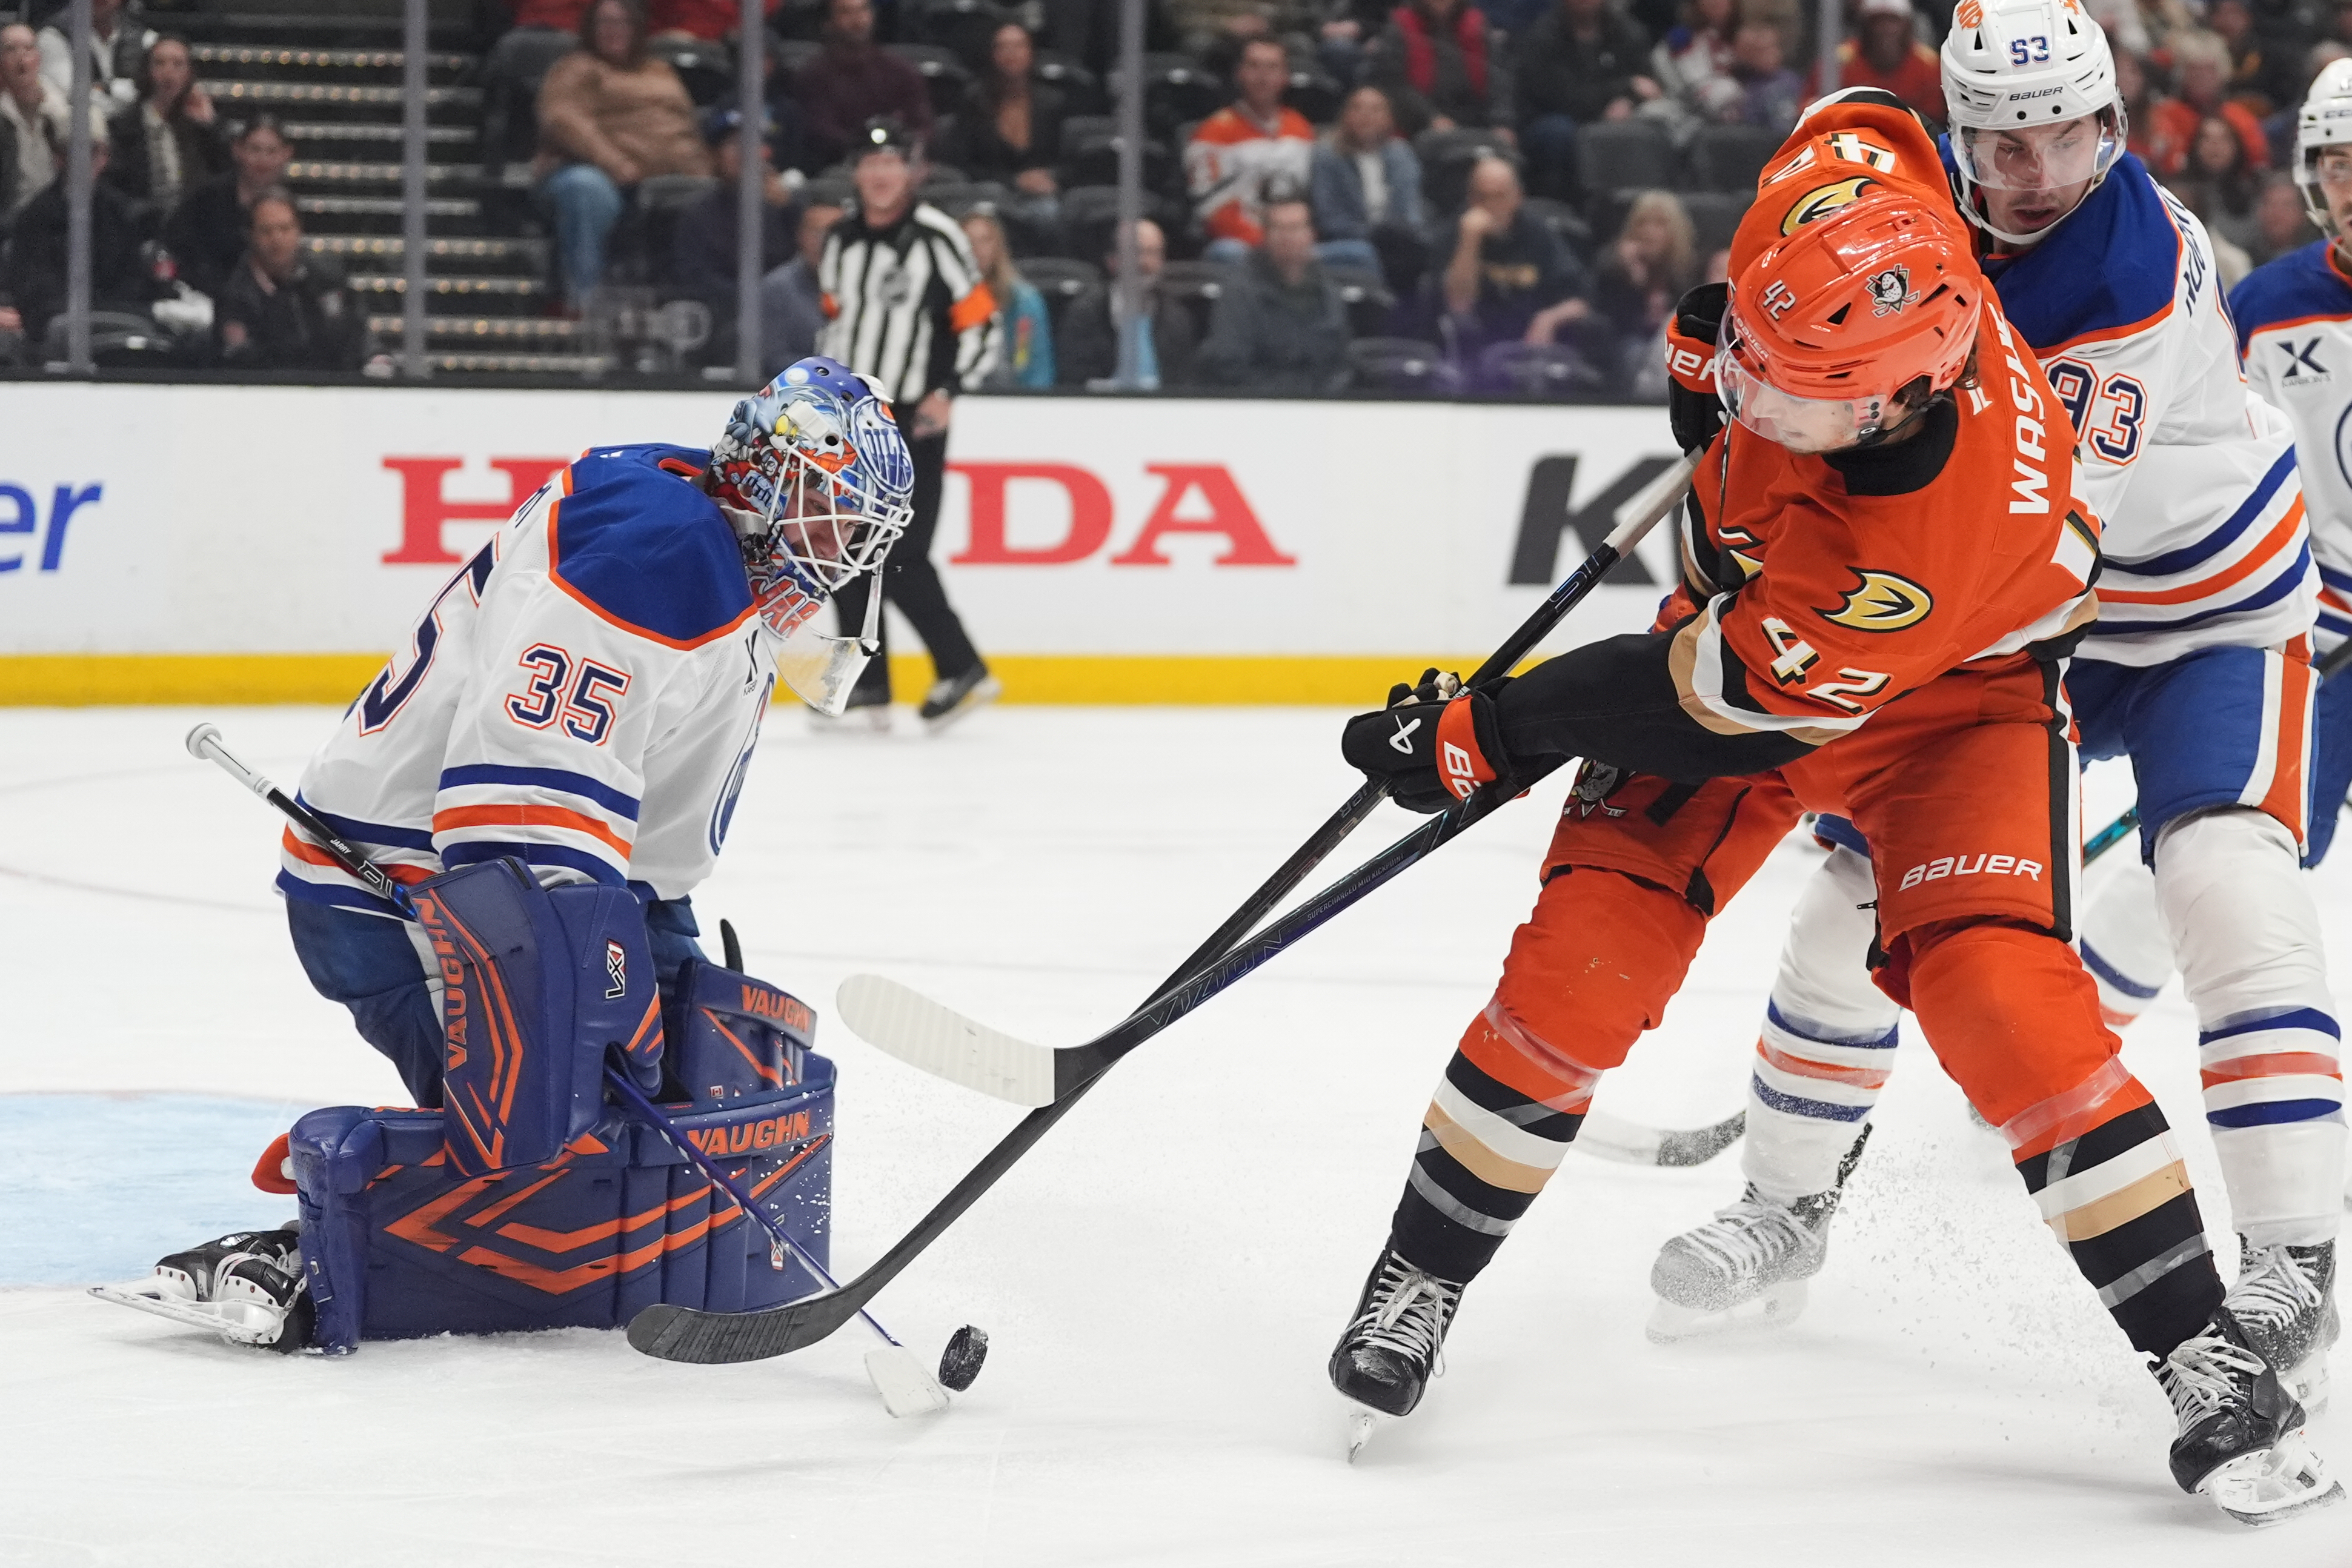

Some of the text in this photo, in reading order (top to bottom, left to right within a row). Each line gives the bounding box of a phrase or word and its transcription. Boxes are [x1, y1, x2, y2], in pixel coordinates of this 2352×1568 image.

[2009, 86, 2064, 101] BAUER
[1762, 279, 1796, 321] 42
[2044, 356, 2148, 467] 93
[382, 457, 1295, 565] HDA
[1761, 616, 1892, 717] 42
[504, 642, 632, 746] 35
[330, 839, 352, 854] JARRY
[1898, 852, 2044, 892] BAUER
[1307, 880, 1358, 921] SUPERCHARGED
[1358, 874, 1372, 888] MID
[412, 898, 467, 1072] VAUGHN
[742, 985, 811, 1032] VAUGHN
[686, 1110, 810, 1157] VAUGHN
